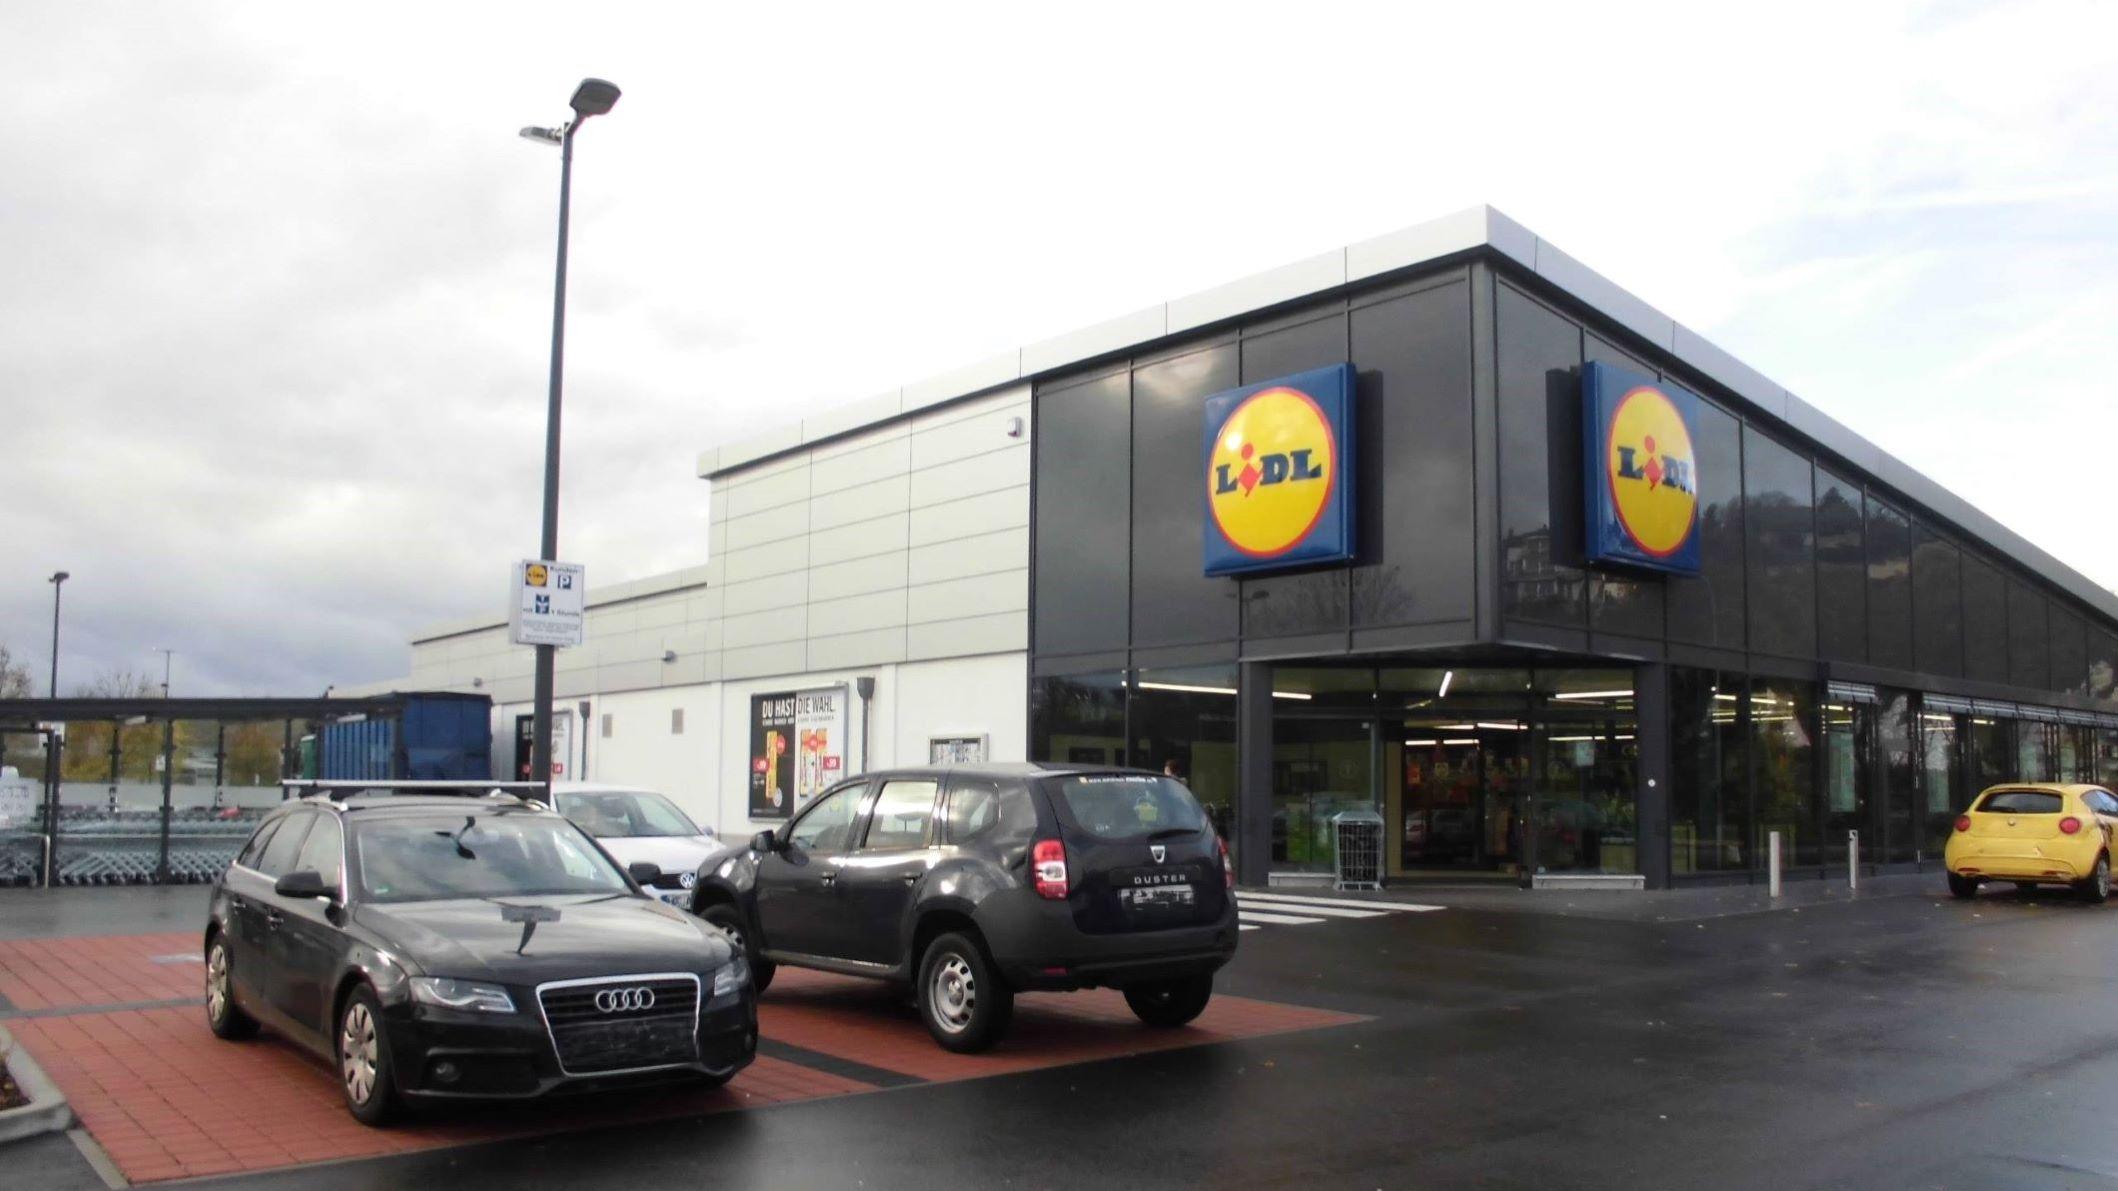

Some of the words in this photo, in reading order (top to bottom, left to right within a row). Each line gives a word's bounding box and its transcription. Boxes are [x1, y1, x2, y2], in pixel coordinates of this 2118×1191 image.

[762, 700, 774, 719] DU
[775, 698, 796, 718] HAST
[798, 696, 811, 714] DIE
[1134, 874, 1186, 885] DUSTER
